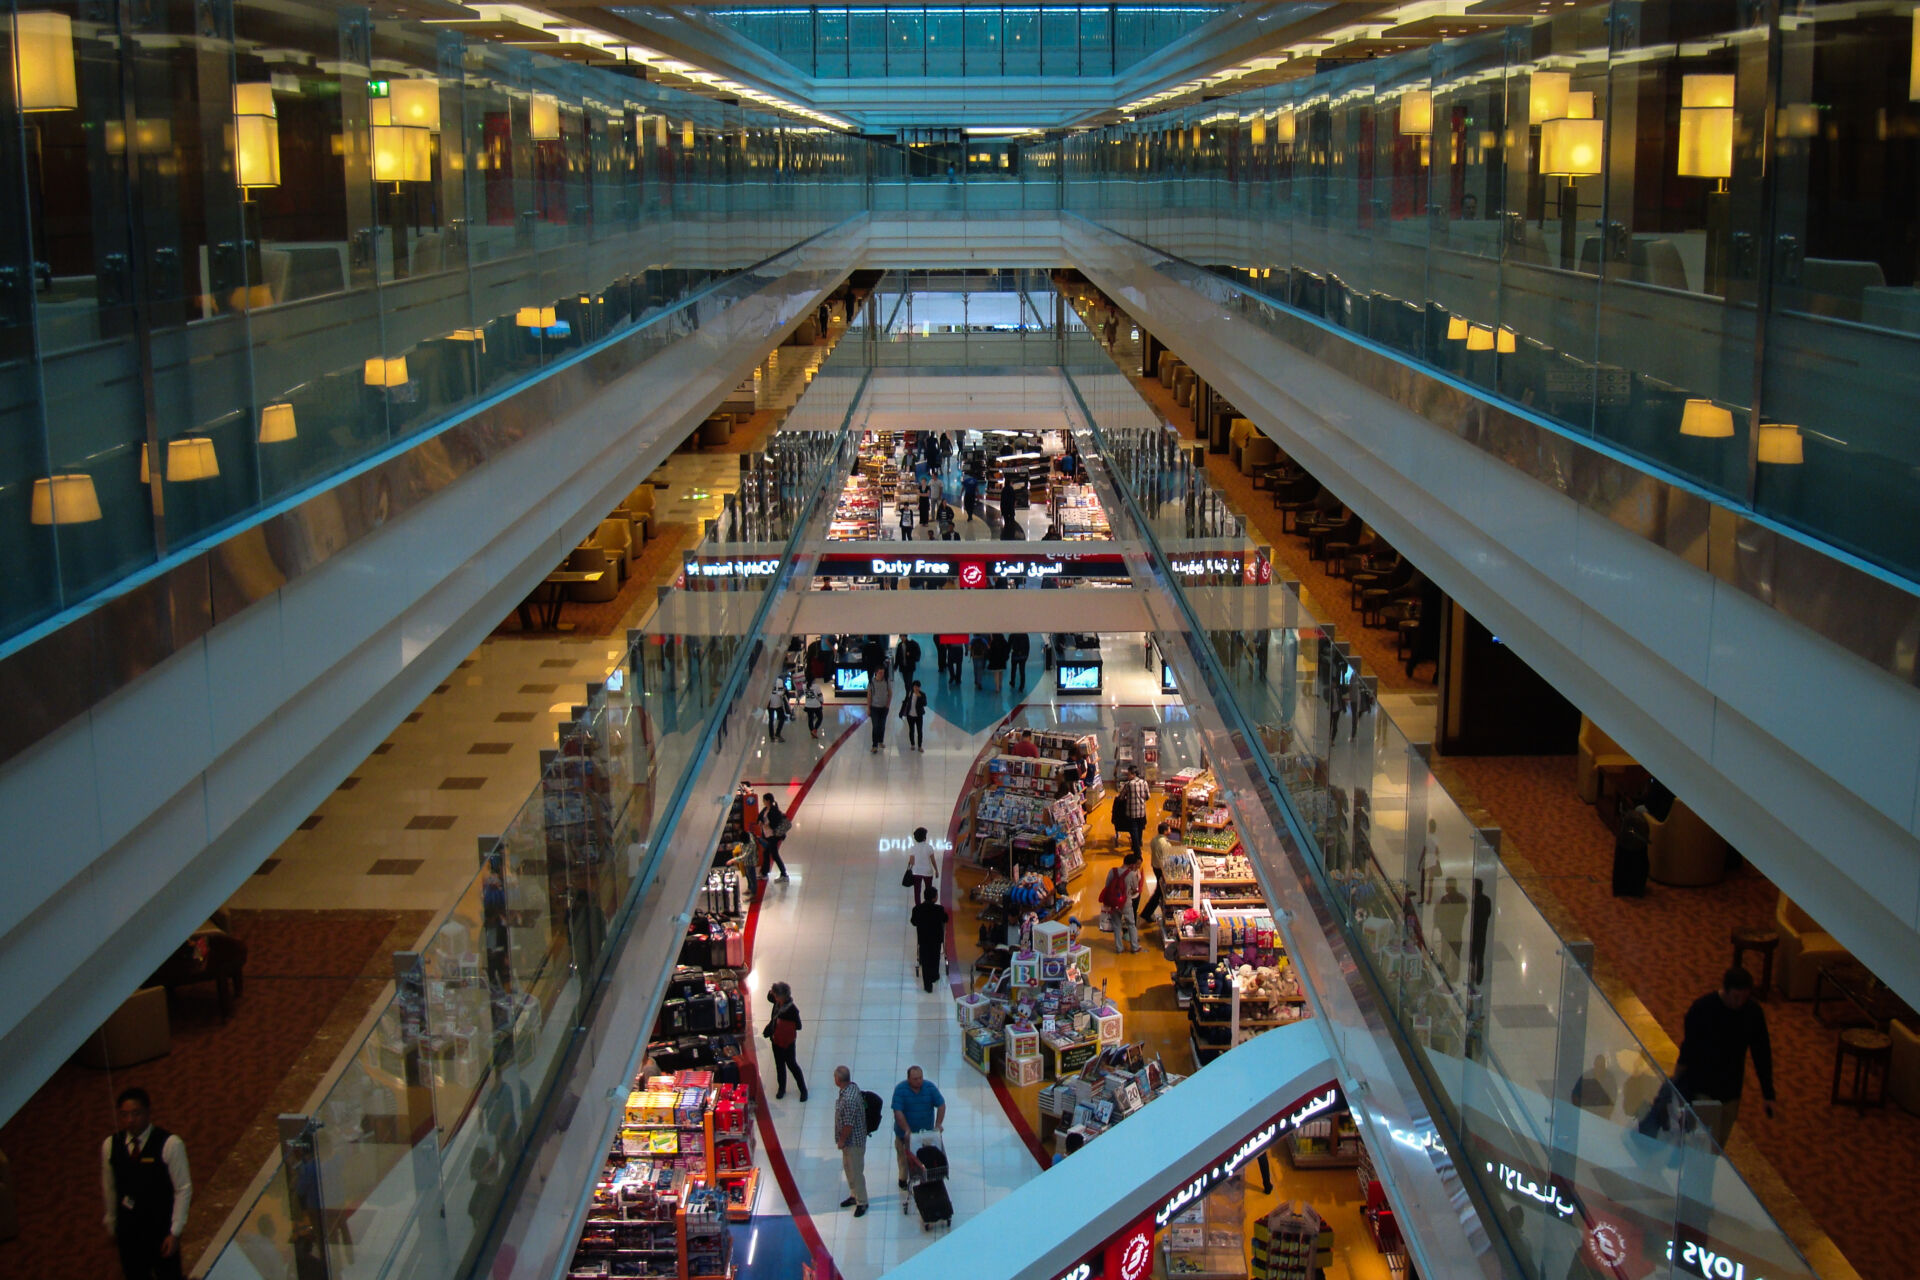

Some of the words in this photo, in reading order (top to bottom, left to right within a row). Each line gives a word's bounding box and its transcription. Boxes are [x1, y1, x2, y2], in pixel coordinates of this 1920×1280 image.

[872, 559, 912, 577] Duty
[915, 559, 950, 574] Free
[1027, 561, 1062, 577] السوق
[1103, 1020, 1117, 1038] G
[1128, 1087, 1138, 1101] 20
